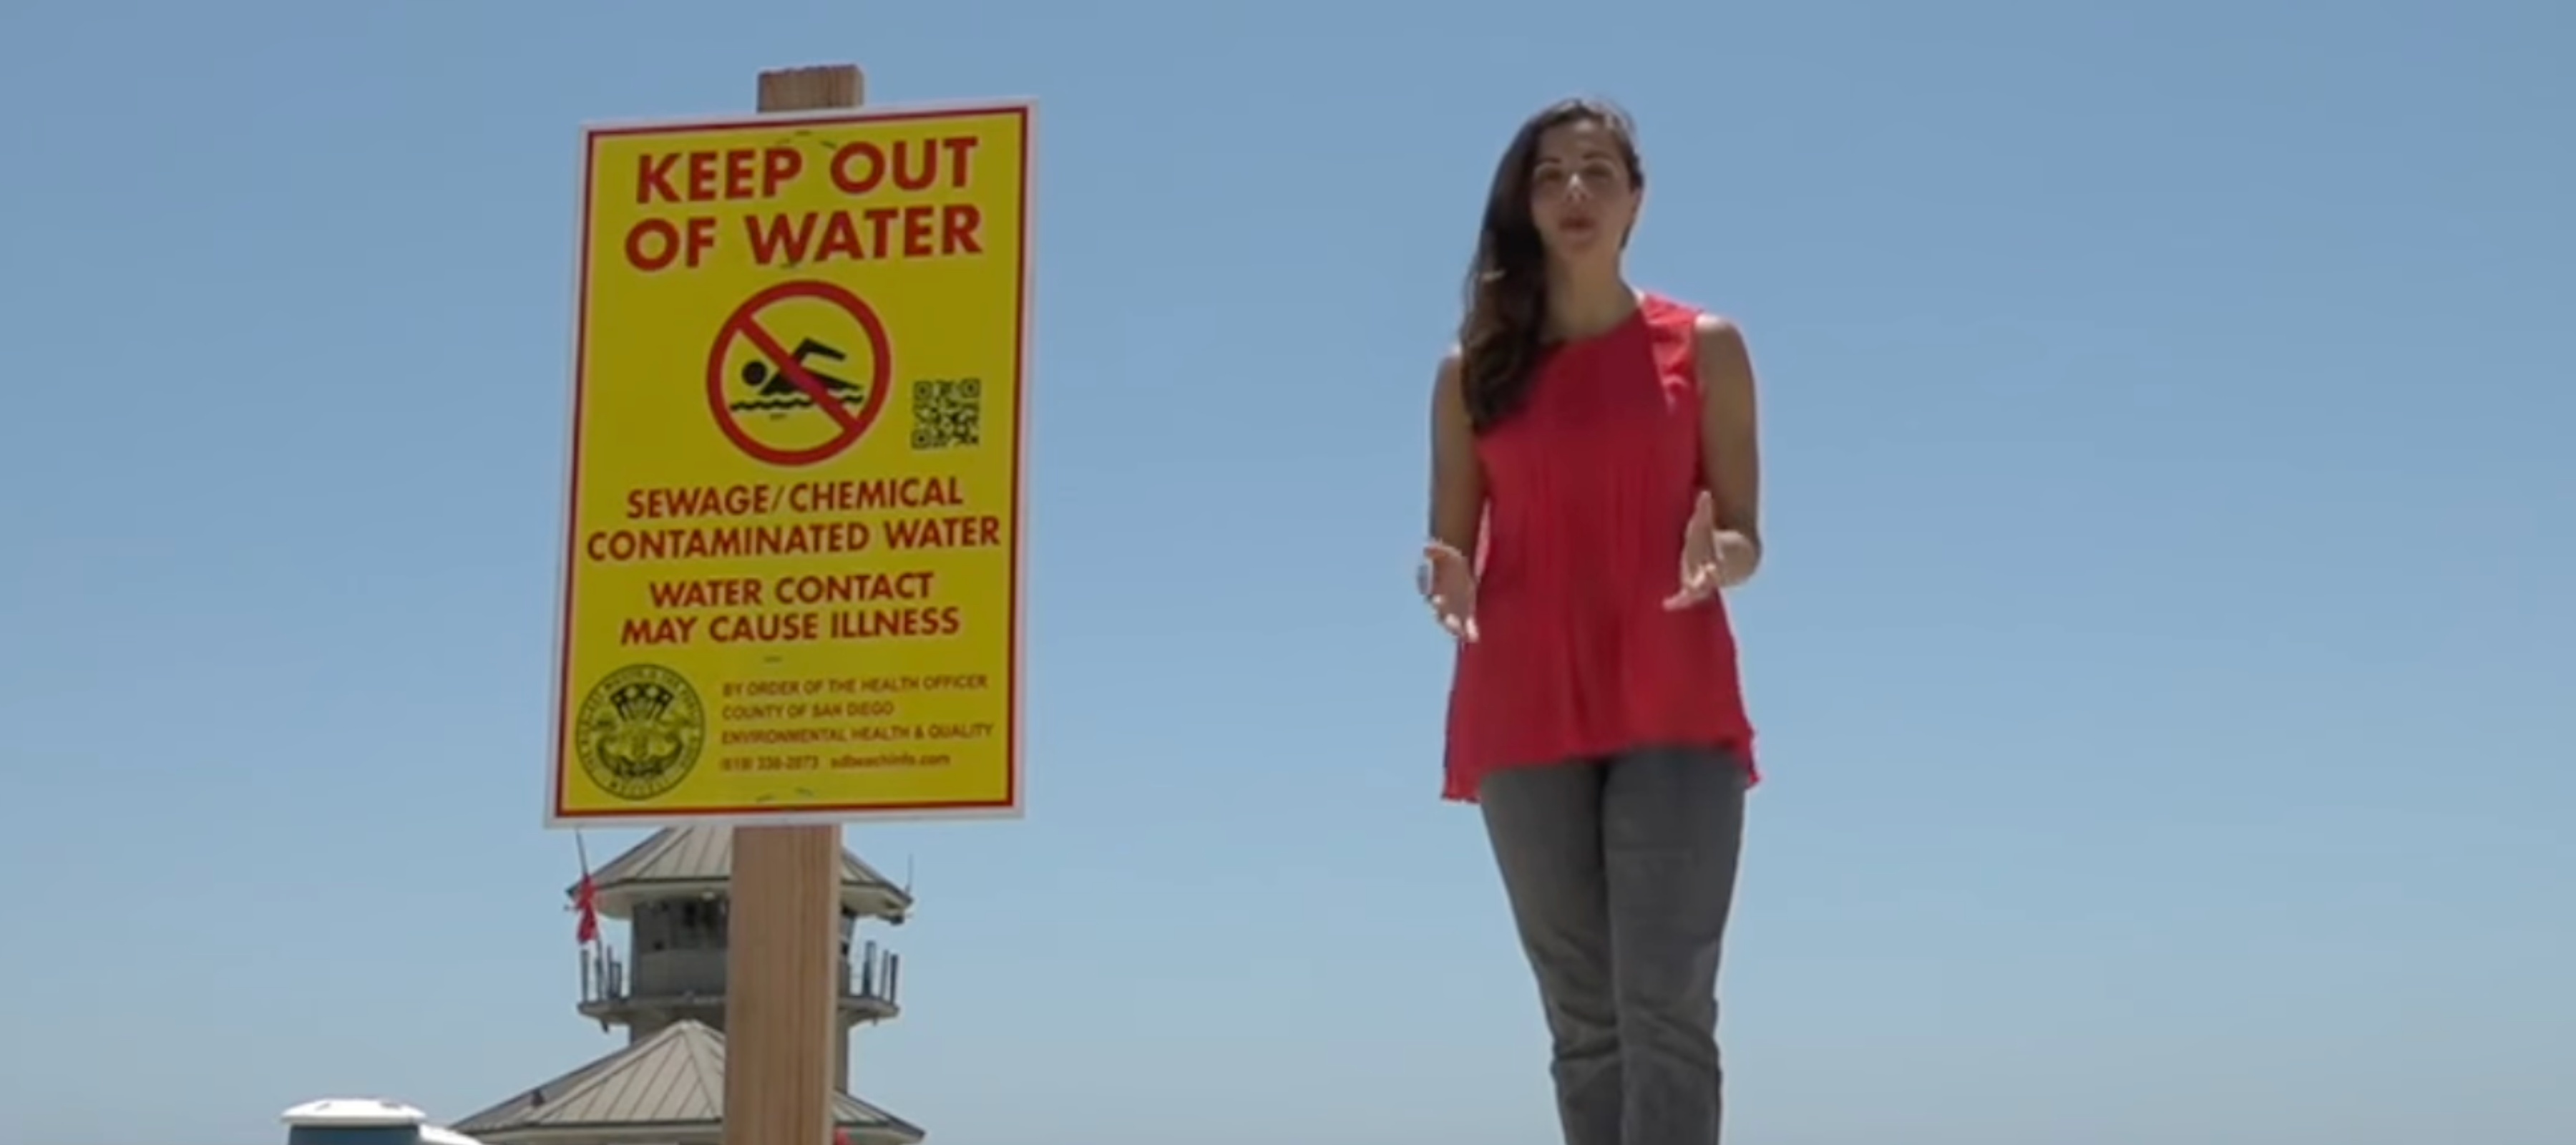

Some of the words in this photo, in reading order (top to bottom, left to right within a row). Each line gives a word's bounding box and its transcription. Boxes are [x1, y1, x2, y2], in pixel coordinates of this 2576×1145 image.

[638, 147, 801, 203] KEEP
[830, 137, 977, 194] OUT
[625, 218, 716, 271] OF
[745, 205, 981, 265] WATER
[628, 477, 964, 518] SEWAGE/CHEMICAL
[587, 522, 869, 561] CONTAMINATED
[884, 516, 1000, 549] WATER
[650, 578, 762, 608] WATER
[775, 571, 934, 605] CONTACT
[621, 617, 697, 645] MAY
[708, 613, 818, 643] CAUSE
[831, 606, 960, 638] ILLNESS
[723, 682, 743, 698] BY
[746, 681, 800, 696] ORDER
[803, 679, 824, 695] OF
[828, 678, 856, 693] THE
[861, 676, 919, 692] HEALTH
[922, 674, 987, 691] OFFICER
[722, 704, 784, 721] COUNTY
[787, 703, 806, 718] OF
[811, 703, 843, 718] SAN
[847, 701, 894, 717] DIEGO
[721, 728, 847, 745] ENVIRONMENTAL
[851, 725, 910, 741] HEALTH
[928, 723, 993, 739] QUALITY
